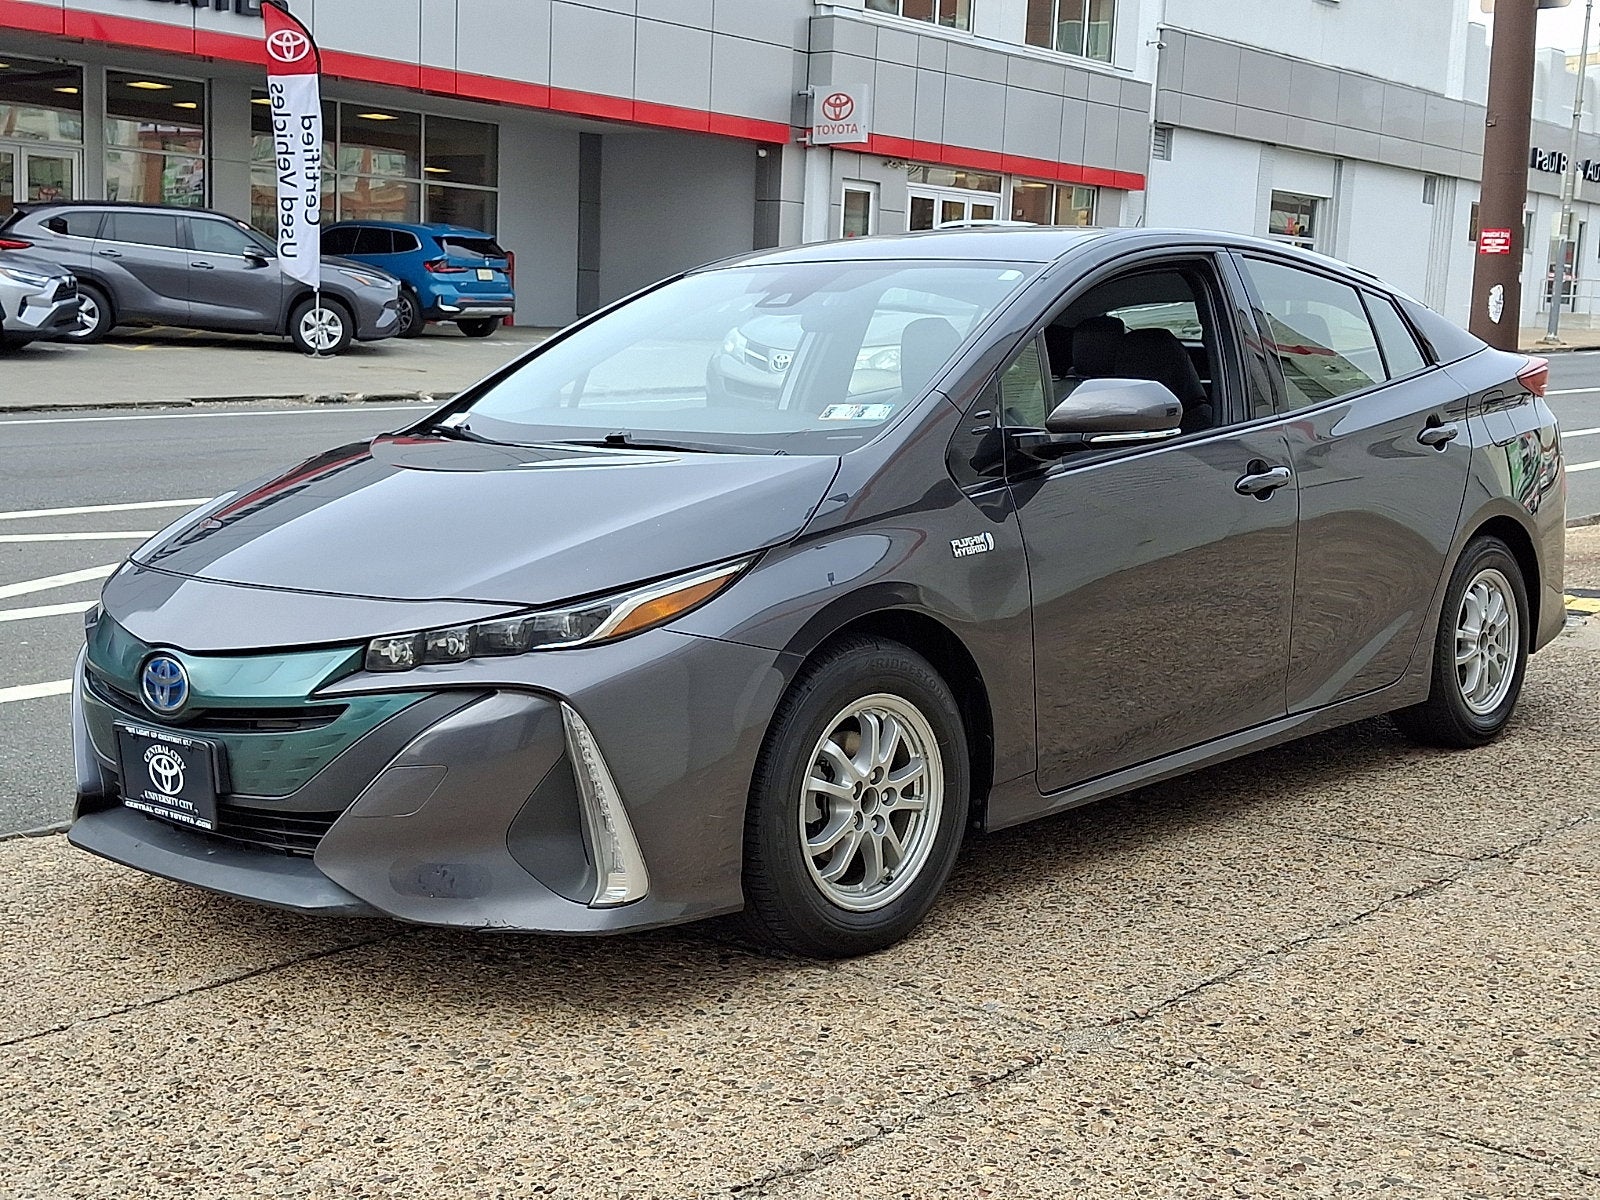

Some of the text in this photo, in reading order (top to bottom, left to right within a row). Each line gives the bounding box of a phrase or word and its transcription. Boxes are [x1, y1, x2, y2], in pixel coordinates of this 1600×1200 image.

[816, 123, 858, 135] TOYOTA
[1534, 147, 1559, 173] Paul
[951, 532, 985, 548] PLUG-IN
[953, 544, 988, 558] HYBRID
[144, 744, 187, 770] CENTRAL CITY
[125, 800, 153, 813] CENTRAL
[154, 808, 169, 817] CITY
[144, 790, 193, 811] UNIVERSITY CITY
